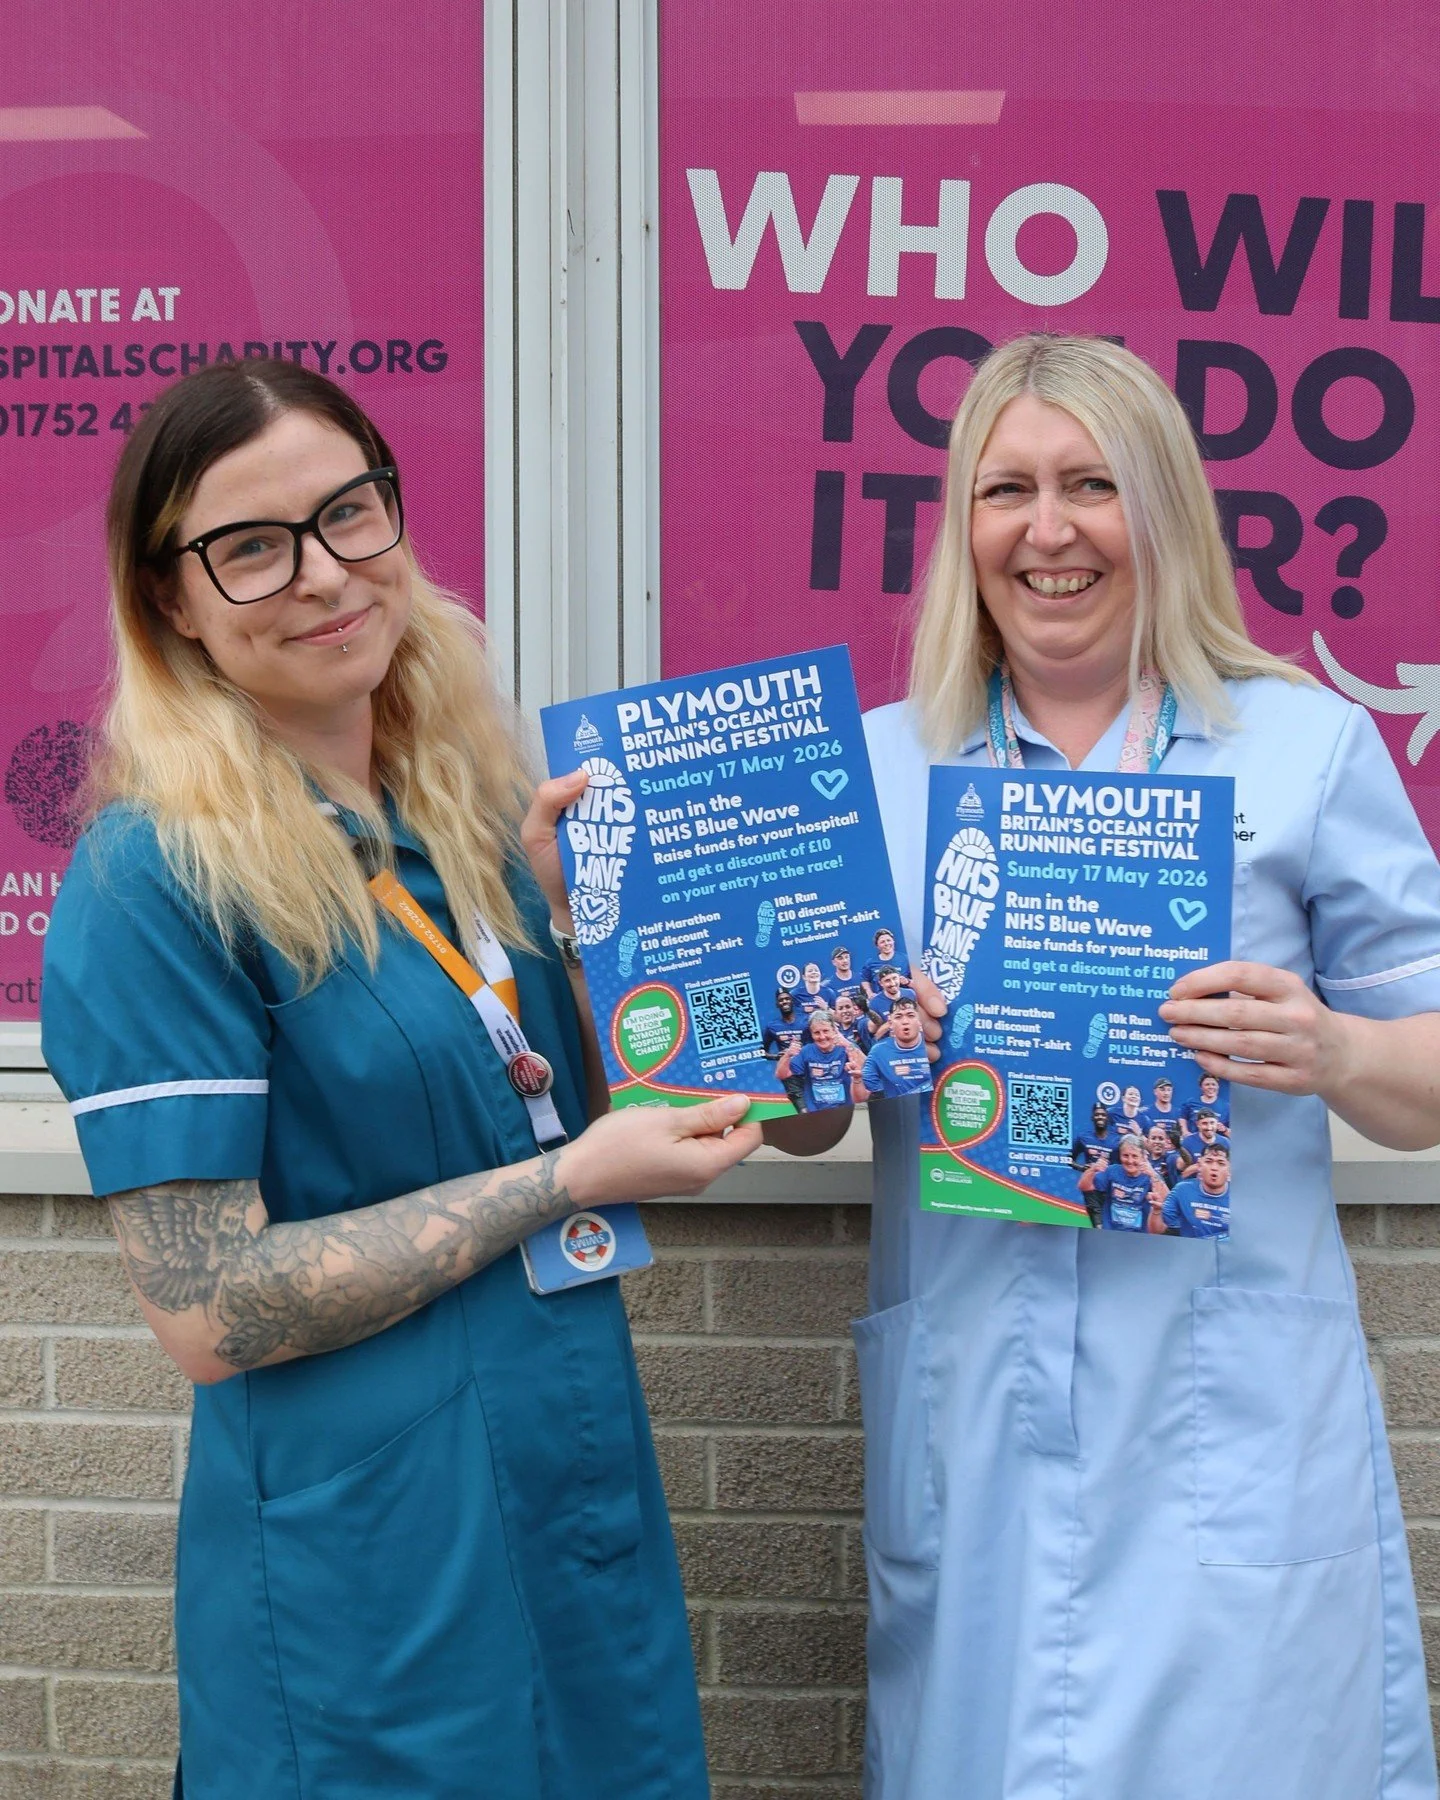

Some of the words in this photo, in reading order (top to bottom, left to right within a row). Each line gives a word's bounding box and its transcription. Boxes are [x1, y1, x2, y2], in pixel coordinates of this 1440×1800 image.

[686, 168, 1109, 306] WHO
[1155, 189, 1440, 324] WIL
[131, 287, 180, 322] AT
[793, 320, 1124, 452] YO
[1174, 339, 1416, 471] DO
[809, 470, 942, 595] IT
[1214, 489, 1388, 620] R?
[616, 665, 821, 733] PLYMOUTH
[621, 720, 710, 751] BRITAIN'S
[713, 705, 777, 732] OCEAN
[780, 696, 822, 718] CITY
[625, 736, 727, 772] RUNNING
[730, 715, 829, 750] FESTIVAL
[639, 769, 713, 795] Sunday
[717, 760, 736, 778] 17
[741, 754, 784, 774] May
[792, 739, 842, 763] 2026
[565, 785, 635, 822] NHS
[644, 807, 684, 825] Run
[686, 800, 706, 817] in
[708, 794, 742, 811] the
[1002, 782, 1200, 820] PLYMOUTH
[649, 822, 692, 846] NHS
[694, 817, 738, 836] Blue
[740, 804, 799, 826] Wave
[1000, 814, 1084, 833] BRITAIN'S
[1087, 818, 1151, 836] OCEAN
[1155, 821, 1199, 838] CITY
[1233, 812, 1246, 824] t
[565, 820, 635, 854] BLUE
[653, 848, 692, 864] Raise
[693, 837, 735, 856] funds
[737, 834, 758, 846] for
[760, 827, 793, 844] your
[795, 811, 859, 834] hospital!
[1000, 833, 1096, 855] RUNNING
[1100, 838, 1199, 860] FESTIVAL
[1233, 830, 1257, 842] er
[574, 854, 626, 891] WAVE
[657, 867, 685, 884] and
[687, 863, 713, 881] get
[714, 862, 724, 872] a
[727, 847, 788, 870] discount
[790, 842, 805, 856] of
[808, 837, 831, 853] £10
[934, 848, 1000, 898] NHS
[1, 872, 42, 896] AN
[661, 892, 680, 903] on
[682, 883, 716, 901] your
[719, 874, 758, 891] entry
[761, 871, 778, 882] to
[779, 865, 804, 878] the
[807, 854, 843, 873] race!
[1006, 860, 1078, 884] Sunday
[1082, 864, 1101, 881] 17
[1106, 865, 1149, 888] May
[1157, 868, 1208, 887] 2026
[774, 895, 794, 907] 10k
[794, 892, 817, 903] Run
[777, 909, 796, 922] £10
[797, 900, 846, 918] discount
[933, 883, 995, 929] BLUE
[1005, 891, 1041, 909] Run
[1045, 892, 1063, 910] in
[1066, 894, 1099, 913] the
[637, 921, 663, 936] Half
[665, 912, 720, 930] Marathon
[780, 922, 811, 936] PLUS
[812, 919, 839, 930] Free
[839, 909, 880, 925] T-shirt
[1005, 912, 1045, 931] NHS
[1049, 915, 1091, 933] Blue
[1094, 917, 1152, 937] Wave
[640, 938, 659, 951] £10
[661, 928, 709, 946] discount
[643, 950, 674, 965] PLUS
[676, 947, 702, 958] Free
[702, 936, 743, 952] T-shirt
[929, 916, 980, 962] WAVE
[1004, 935, 1041, 950] Raise
[1043, 937, 1083, 952] funds
[1085, 940, 1107, 954] for
[1109, 945, 1142, 957] your
[1144, 944, 1208, 961] hospital!
[1003, 957, 1030, 970] and
[1032, 960, 1056, 974] get
[1058, 963, 1068, 972] a
[1070, 961, 1131, 977] discount
[1133, 965, 1150, 978] of
[1152, 965, 1175, 980] £10
[0, 977, 42, 1003] at
[684, 980, 700, 989] Find
[700, 978, 713, 986] out
[713, 975, 731, 983] more
[1002, 979, 1020, 988] on
[1023, 980, 1057, 992] your
[1058, 981, 1099, 997] entry
[1101, 983, 1117, 995] to
[1119, 984, 1144, 997] the
[1146, 988, 1170, 1000] rac
[638, 1010, 665, 1022] DOING
[643, 1019, 659, 1028] FOR
[974, 1003, 1000, 1015] Half
[1000, 1005, 1055, 1019] Marathon
[1108, 1013, 1127, 1024] 10k
[1128, 1014, 1151, 1026] Run
[627, 1025, 670, 1042] PLYMOUTH
[974, 1018, 992, 1029] £10
[994, 1020, 1041, 1033] discount
[1108, 1028, 1127, 1039] £10
[1128, 1030, 1172, 1042] discoun
[629, 1033, 672, 1049] HOSPITALS
[634, 1042, 668, 1056] CHARITY
[975, 1034, 1004, 1045] PLUS
[1006, 1035, 1031, 1047] Free
[1030, 1037, 1071, 1050] T-shirt
[1109, 1043, 1139, 1055] PLUS
[1142, 1046, 1168, 1057] Free
[1168, 1047, 1195, 1059] T-sh
[700, 1058, 716, 1068] Call
[570, 1233, 605, 1250] SWIMS
